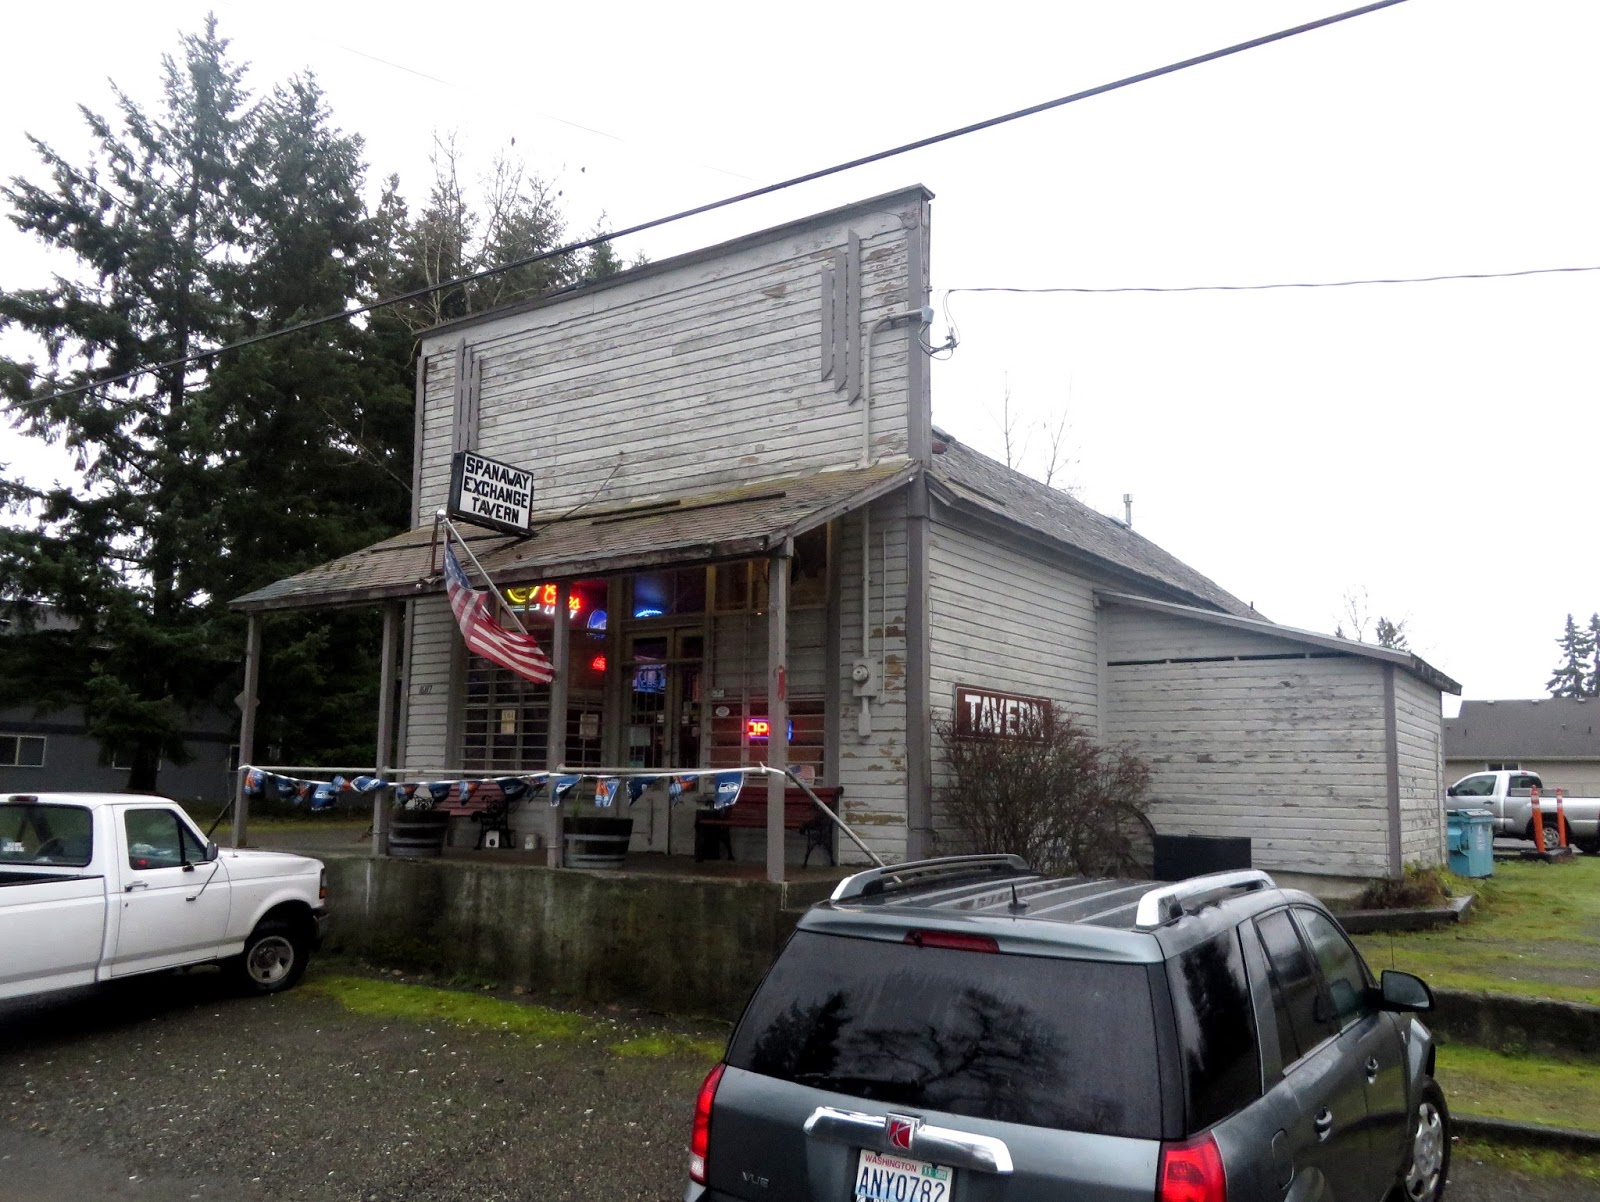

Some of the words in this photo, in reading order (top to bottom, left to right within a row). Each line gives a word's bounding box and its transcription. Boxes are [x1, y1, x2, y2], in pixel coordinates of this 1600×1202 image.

[465, 456, 530, 490] SPANAWAY
[463, 475, 529, 509] EXCHANGE
[472, 496, 520, 524] TAVERN
[964, 694, 1045, 738] TAVERN
[742, 1170, 769, 1188] VUE
[865, 1154, 917, 1172] WASHINGTON
[858, 1166, 946, 1202] ANY0782
